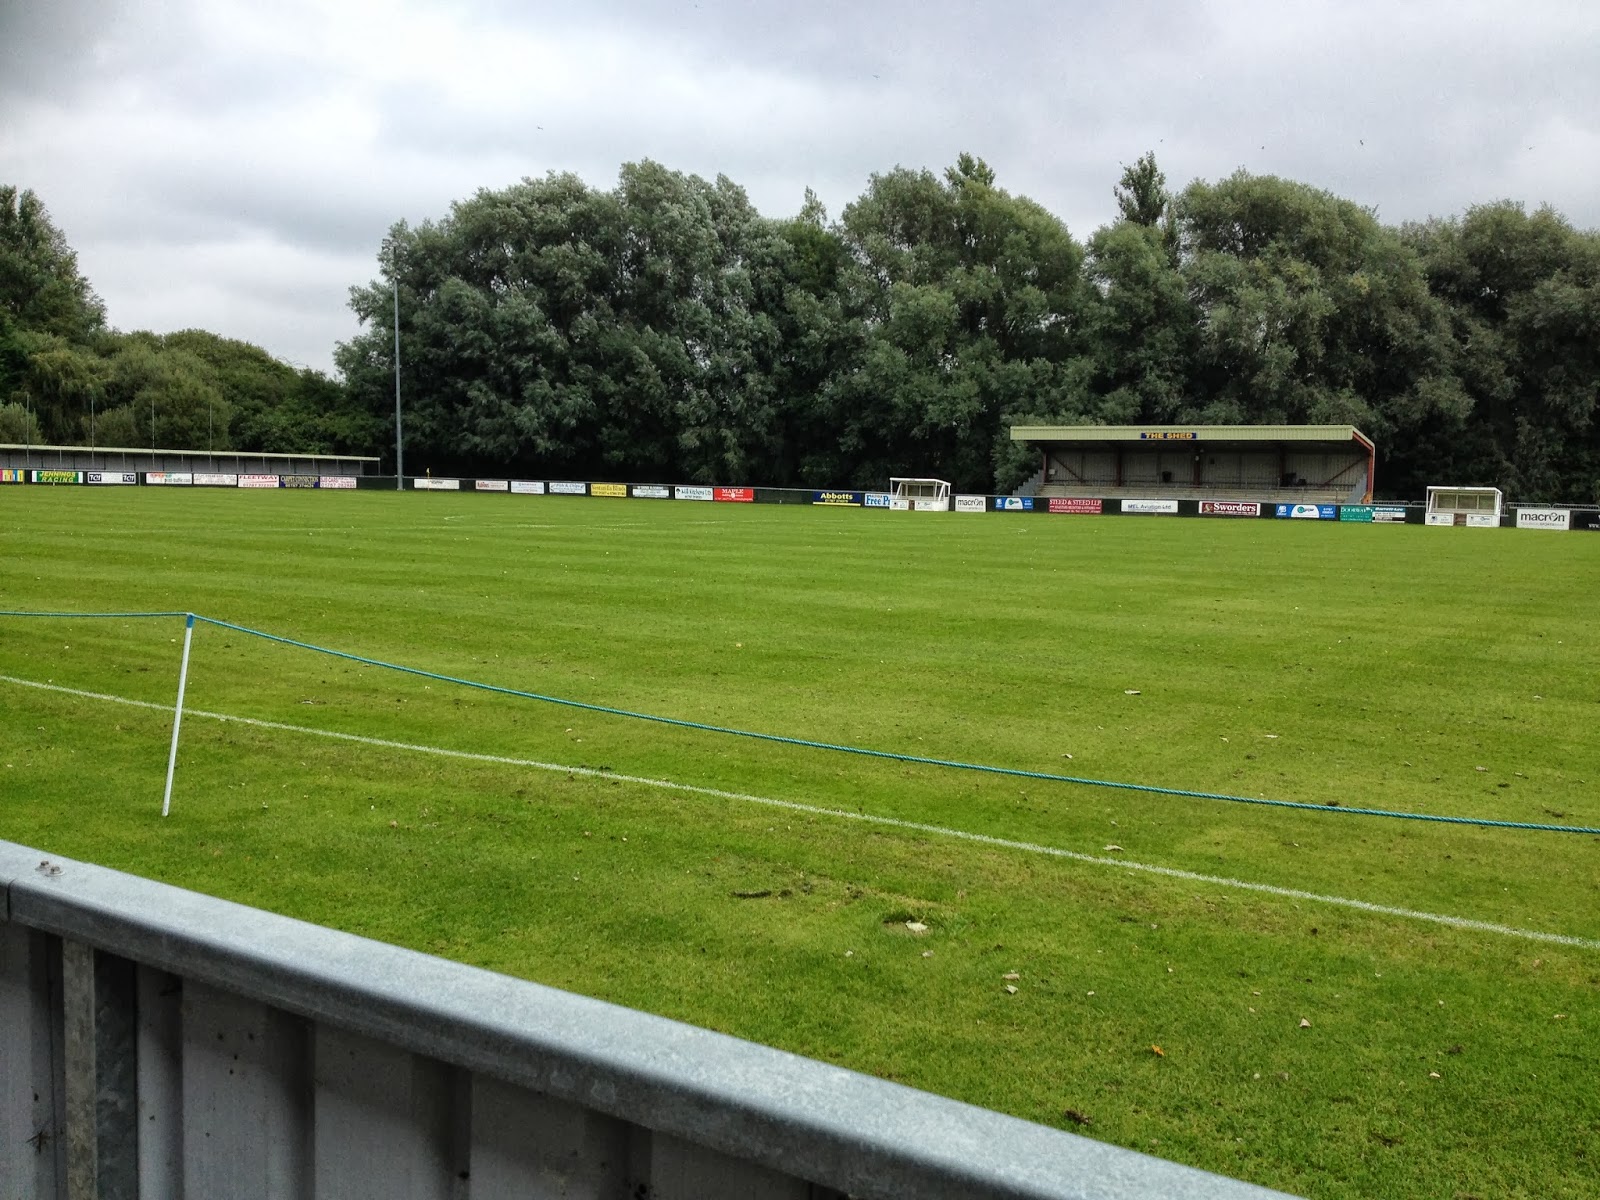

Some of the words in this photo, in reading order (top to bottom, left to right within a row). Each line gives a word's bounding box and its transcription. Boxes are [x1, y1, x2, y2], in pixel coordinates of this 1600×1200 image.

[820, 492, 853, 500] Abbotts
[866, 494, 881, 505] Free
[957, 498, 984, 506] macron
[1213, 502, 1257, 512] Sworders
[1520, 512, 1565, 522] macron
